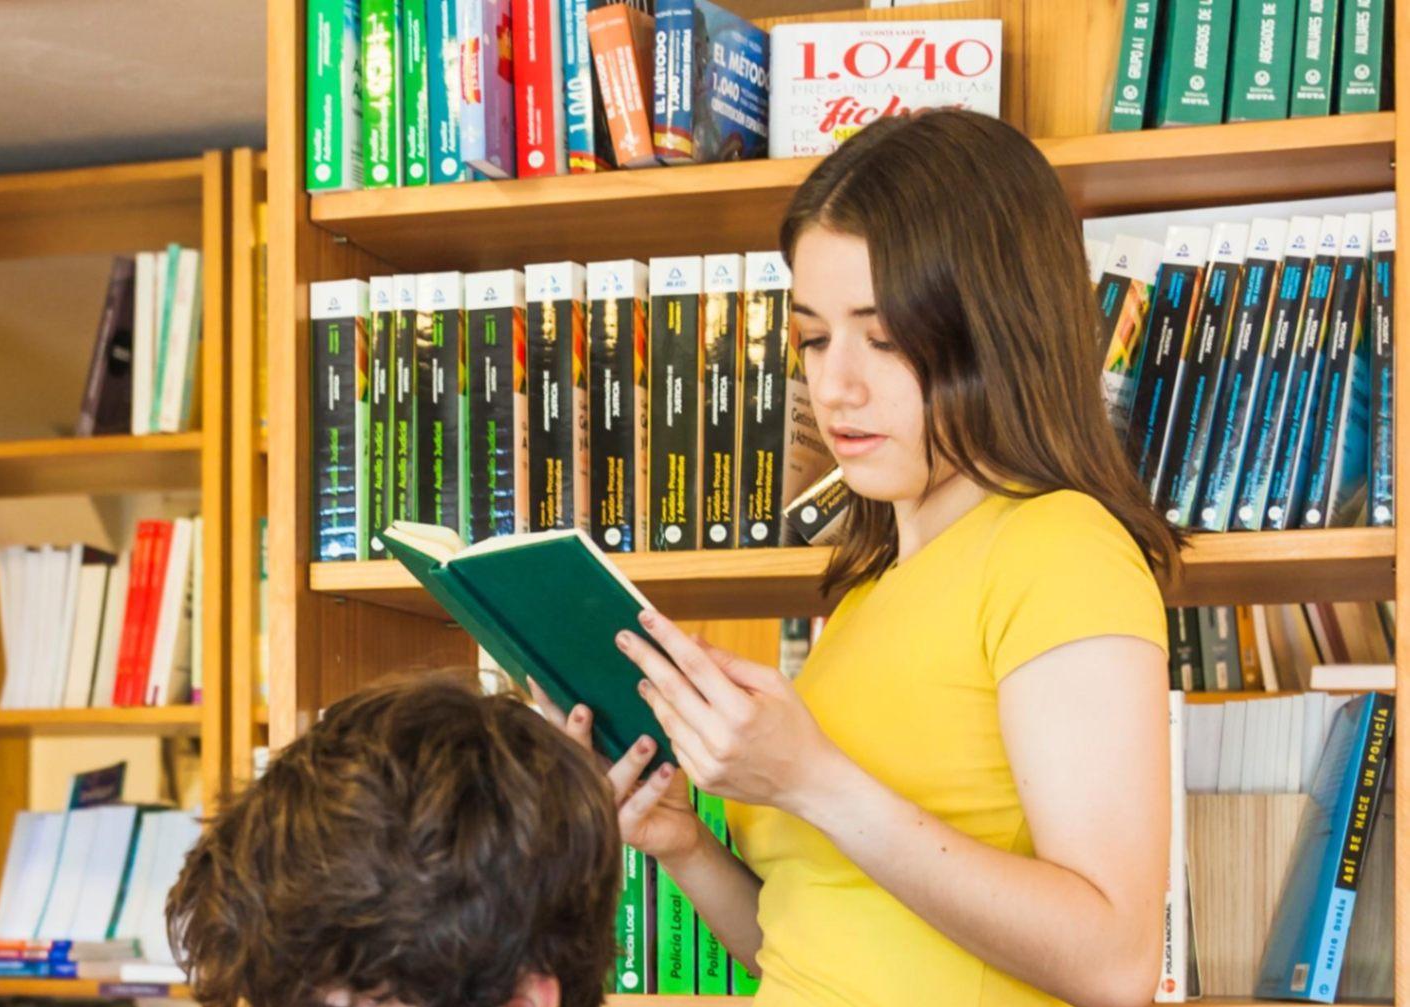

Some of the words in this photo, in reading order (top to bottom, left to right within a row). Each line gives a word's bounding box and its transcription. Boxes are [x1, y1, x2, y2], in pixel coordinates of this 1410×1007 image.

[1135, 16, 1148, 29] DE
[1199, 8, 1213, 22] DE
[1262, 2, 1277, 15] DE
[713, 42, 726, 67] EL
[1194, 24, 1212, 69] ABOGADOS
[1259, 19, 1276, 64] ABOGADOS
[654, 31, 666, 96] MÉTODO
[793, 38, 994, 81] 1.040
[1127, 49, 1144, 80] GRUPO
[712, 72, 740, 101] 1.040
[791, 83, 906, 96] PREGUNTAS
[915, 81, 994, 93] CORTAS
[655, 97, 666, 115] EL
[550, 382, 558, 418] JUSTICIA
[611, 379, 620, 418] JUSTICIA
[673, 377, 681, 413] JUSTICIA
[719, 375, 727, 413] JUSTICIA
[763, 372, 772, 410] JUSTICIA
[372, 420, 384, 457] Judicial
[396, 419, 408, 456] Judicial
[433, 419, 443, 456] Judicial
[373, 457, 383, 490] Auxilio
[397, 456, 407, 489] Auxilio
[433, 456, 443, 490] Auxilio
[545, 457, 553, 492] Procesal
[606, 455, 615, 492] Procesal
[667, 453, 675, 488] Procesal
[713, 451, 722, 488] Procesal
[755, 449, 765, 486] Procesal
[545, 493, 553, 525] Gestión
[606, 492, 615, 525] Gestión
[667, 490, 676, 522] Gestión
[713, 488, 722, 522] Gestión
[755, 485, 764, 520] Gestión
[1366, 708, 1388, 763] POLICÍA
[1364, 770, 1376, 787] UN
[1353, 796, 1370, 828] HACE
[1349, 836, 1362, 852] SE
[1343, 859, 1355, 883] ASÍ
[625, 904, 635, 932] Local
[671, 894, 682, 931] Local
[625, 933, 635, 968] Policía
[1325, 938, 1339, 970] MARIO
[1333, 899, 1346, 931] DURÁN
[671, 932, 682, 979] Policía
